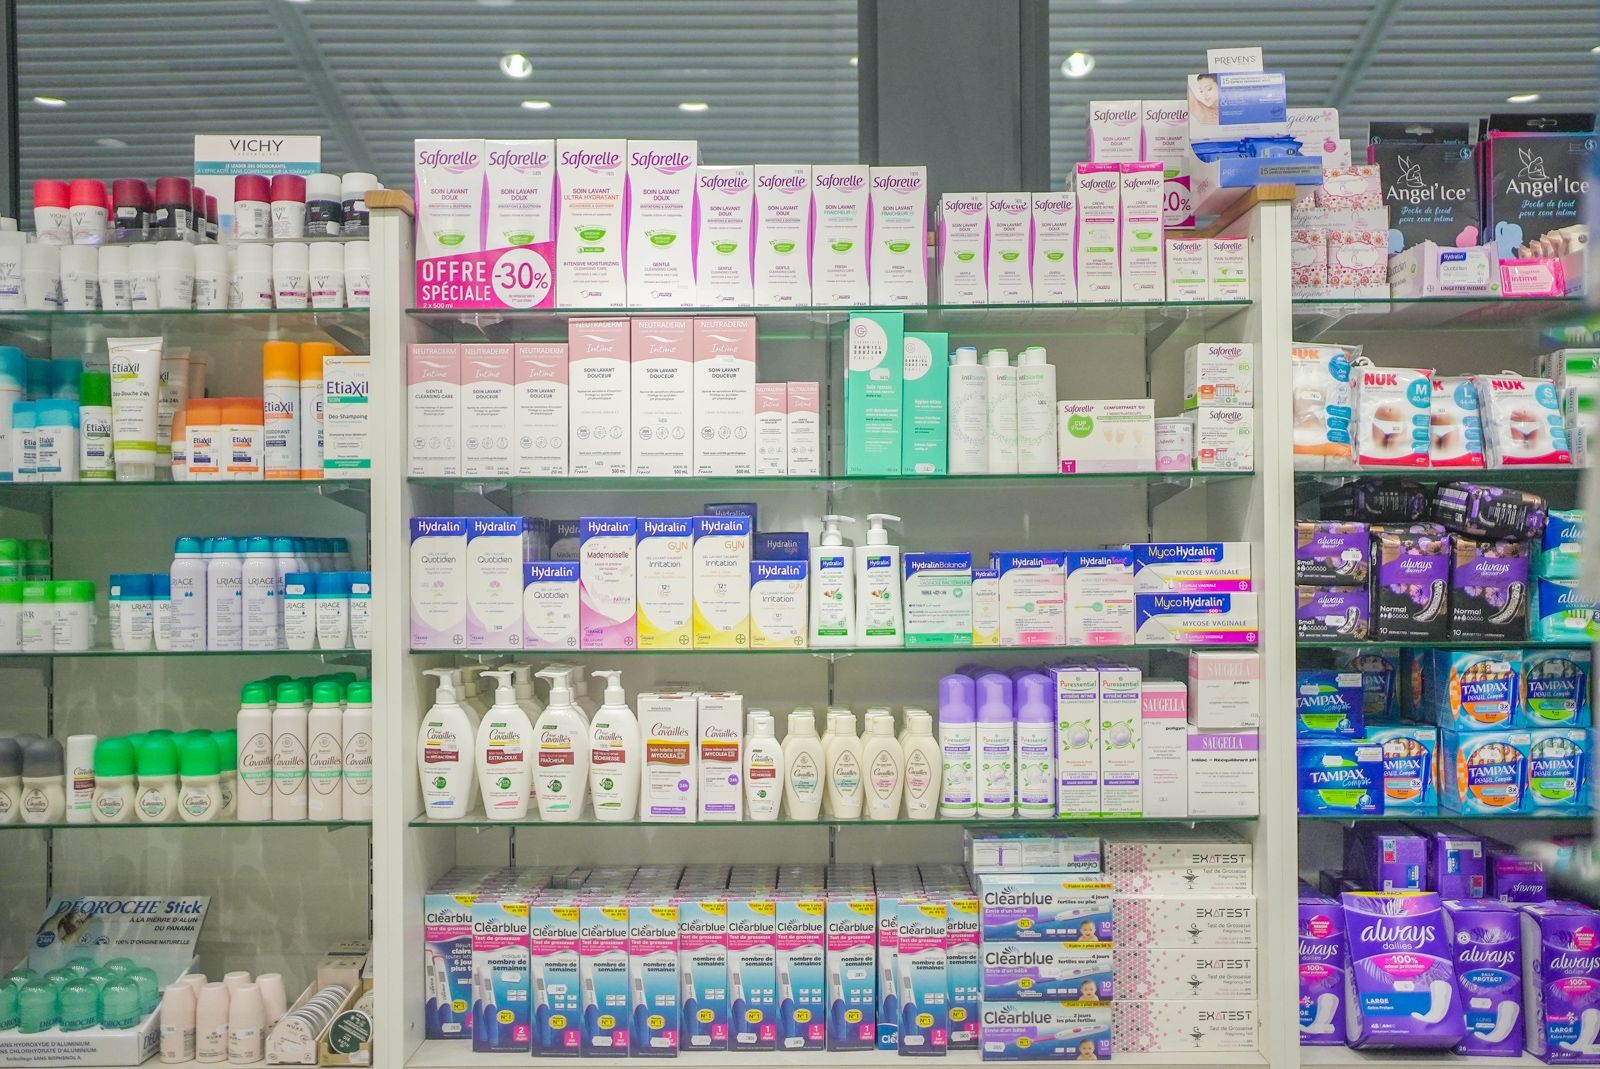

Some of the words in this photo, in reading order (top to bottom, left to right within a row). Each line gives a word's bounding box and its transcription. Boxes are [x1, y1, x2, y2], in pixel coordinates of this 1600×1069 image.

[1094, 110, 1136, 122] Saforelle
[1146, 109, 1188, 121] Saforelle
[230, 140, 283, 151] VICHY
[419, 150, 477, 168] Saforelle
[489, 150, 546, 168] Saforelle
[561, 151, 619, 168] Saforelle
[631, 151, 688, 169] Saforelle
[701, 174, 747, 190] Saforelle
[758, 174, 804, 190] Saforelle
[816, 174, 862, 189] Saforelle
[873, 175, 920, 190] Saforelle
[1080, 179, 1115, 190] Saforelle
[1506, 176, 1589, 197] Angel'Ice
[1386, 185, 1465, 203] Angel'Ice
[1546, 200, 1554, 208] de
[423, 262, 486, 282] OFFRE
[494, 262, 548, 289] -30%
[423, 282, 490, 300] SPÉCIALE
[650, 344, 676, 354] Intime
[1364, 374, 1397, 385] NUK
[1492, 380, 1524, 390] NUK
[1416, 384, 1427, 394] M
[419, 522, 459, 533] Hydralin
[475, 522, 516, 533] Hydralin
[589, 522, 629, 532] Hydralin
[645, 522, 686, 533] Hydralin
[702, 521, 742, 532] Hydralin
[768, 540, 797, 548] Hydralin
[1318, 536, 1344, 547] always
[1149, 546, 1215, 559] MycoHydralin
[758, 565, 799, 576] Hydralin
[1401, 558, 1432, 572] always
[1476, 561, 1510, 574] always
[532, 567, 572, 577] Hydralin
[1155, 597, 1222, 609] MycoHydralin
[1318, 596, 1344, 606] always
[1462, 682, 1508, 694] TAMPAX
[1528, 681, 1574, 691] TAMPAX
[1143, 700, 1184, 712] SAUGELLA
[652, 723, 688, 736] Cavaillès
[705, 726, 738, 738] Cavaillès
[1203, 737, 1243, 749] SAUGELLA
[1310, 769, 1364, 783] TAMPAX
[1469, 765, 1516, 777] TAMPAX
[1193, 854, 1245, 863] EXATEST
[985, 892, 1052, 904] Clearblue
[165, 901, 202, 913] Stick
[1197, 909, 1250, 917] EXATEST
[474, 922, 526, 932] Clearblue
[582, 927, 626, 937] Clearblue
[631, 927, 676, 937] Clearblue
[680, 921, 725, 932] Clearblue
[729, 921, 774, 932] Clearblue
[778, 921, 822, 932] Clearblue
[829, 922, 873, 932] Clearblue
[900, 924, 944, 935] Clearblue
[1361, 919, 1435, 948] always
[986, 951, 1053, 965] Clearblue
[1460, 946, 1515, 968] always
[1197, 960, 1250, 968] EXATEST
[1103, 981, 1111, 989] 10
[984, 1010, 1052, 1024] Clearblue
[1199, 1011, 1252, 1020] EXATEST
